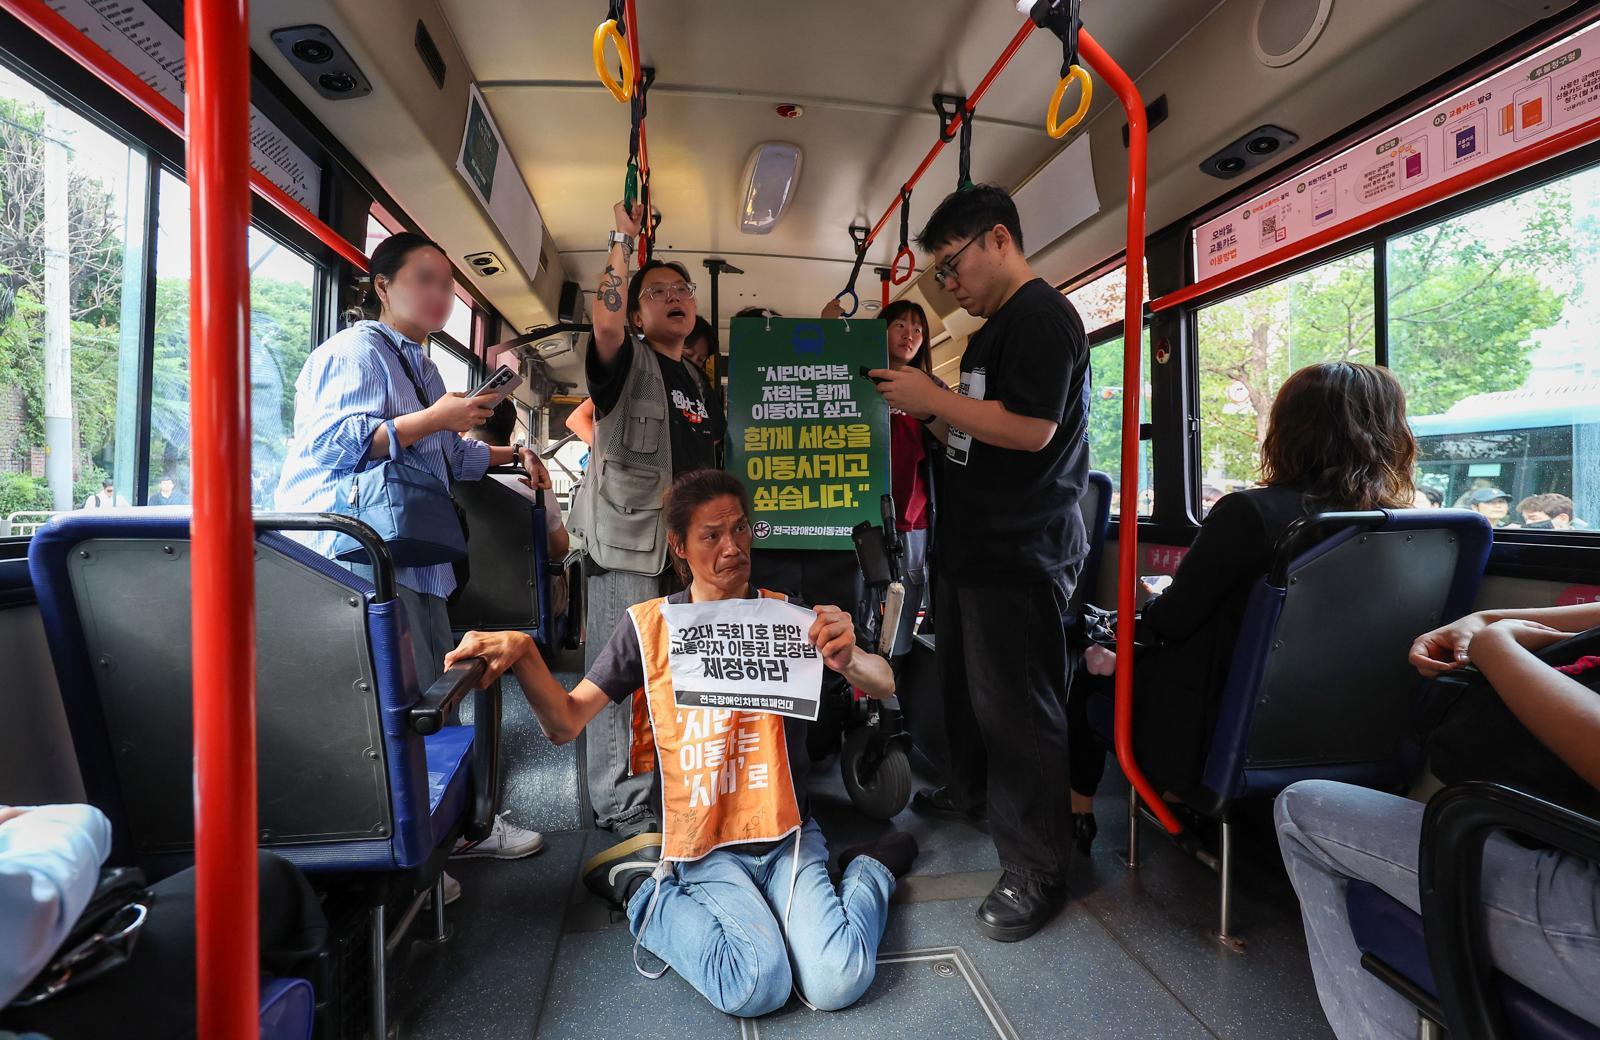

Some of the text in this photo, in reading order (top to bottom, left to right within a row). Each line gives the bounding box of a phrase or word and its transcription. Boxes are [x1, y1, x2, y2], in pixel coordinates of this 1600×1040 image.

[1534, 51, 1576, 77] 후불청구형
[1556, 84, 1582, 101] 신용카드
[1448, 100, 1476, 117] 교통카드
[1211, 223, 1233, 240] 모바일
[1209, 234, 1237, 254] 교통카드
[1209, 248, 1237, 267] 이용방법
[762, 383, 851, 402] 저희는 함께
[752, 401, 862, 420] 이동하고 싶고,
[744, 423, 871, 451] 함께 세상을
[747, 453, 870, 480] 이동시키고
[678, 623, 802, 641] 22대 국회 1호 법안
[671, 640, 818, 659] 교통약자 이동권 보장법
[701, 657, 789, 683] 제정하라
[699, 694, 794, 711] 전국장애인차별철폐연대
